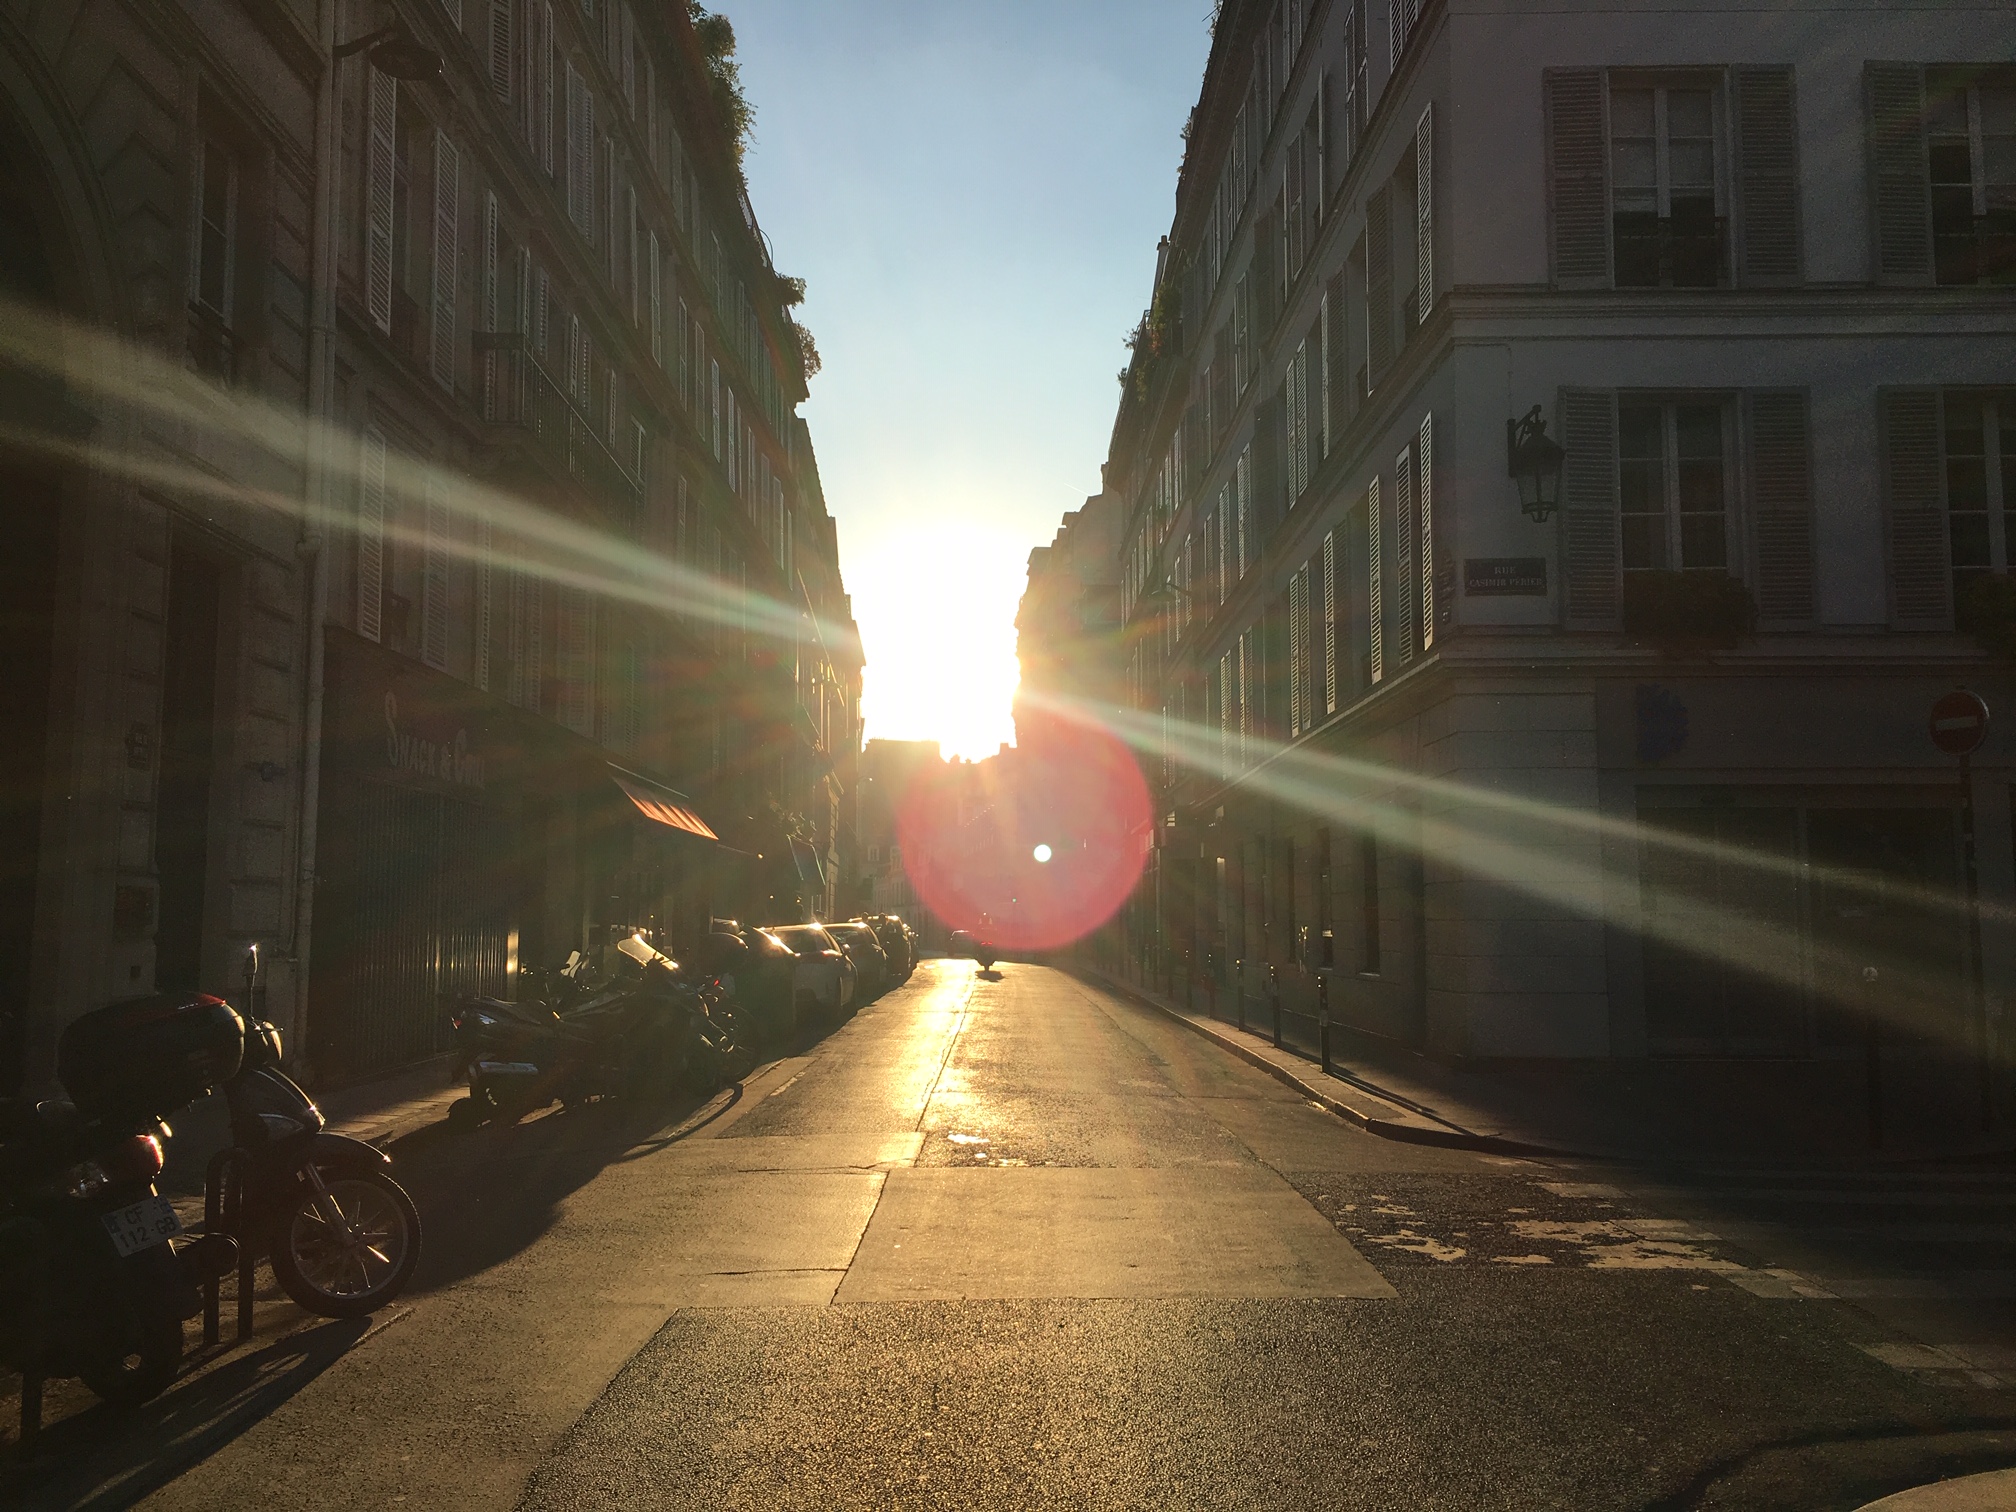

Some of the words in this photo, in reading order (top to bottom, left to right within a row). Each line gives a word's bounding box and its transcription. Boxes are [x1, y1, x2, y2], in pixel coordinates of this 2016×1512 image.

[1494, 566, 1517, 575] RUE
[1469, 578, 1507, 587] CASIMIR
[440, 745, 452, 782] &
[124, 1205, 143, 1225] CF
